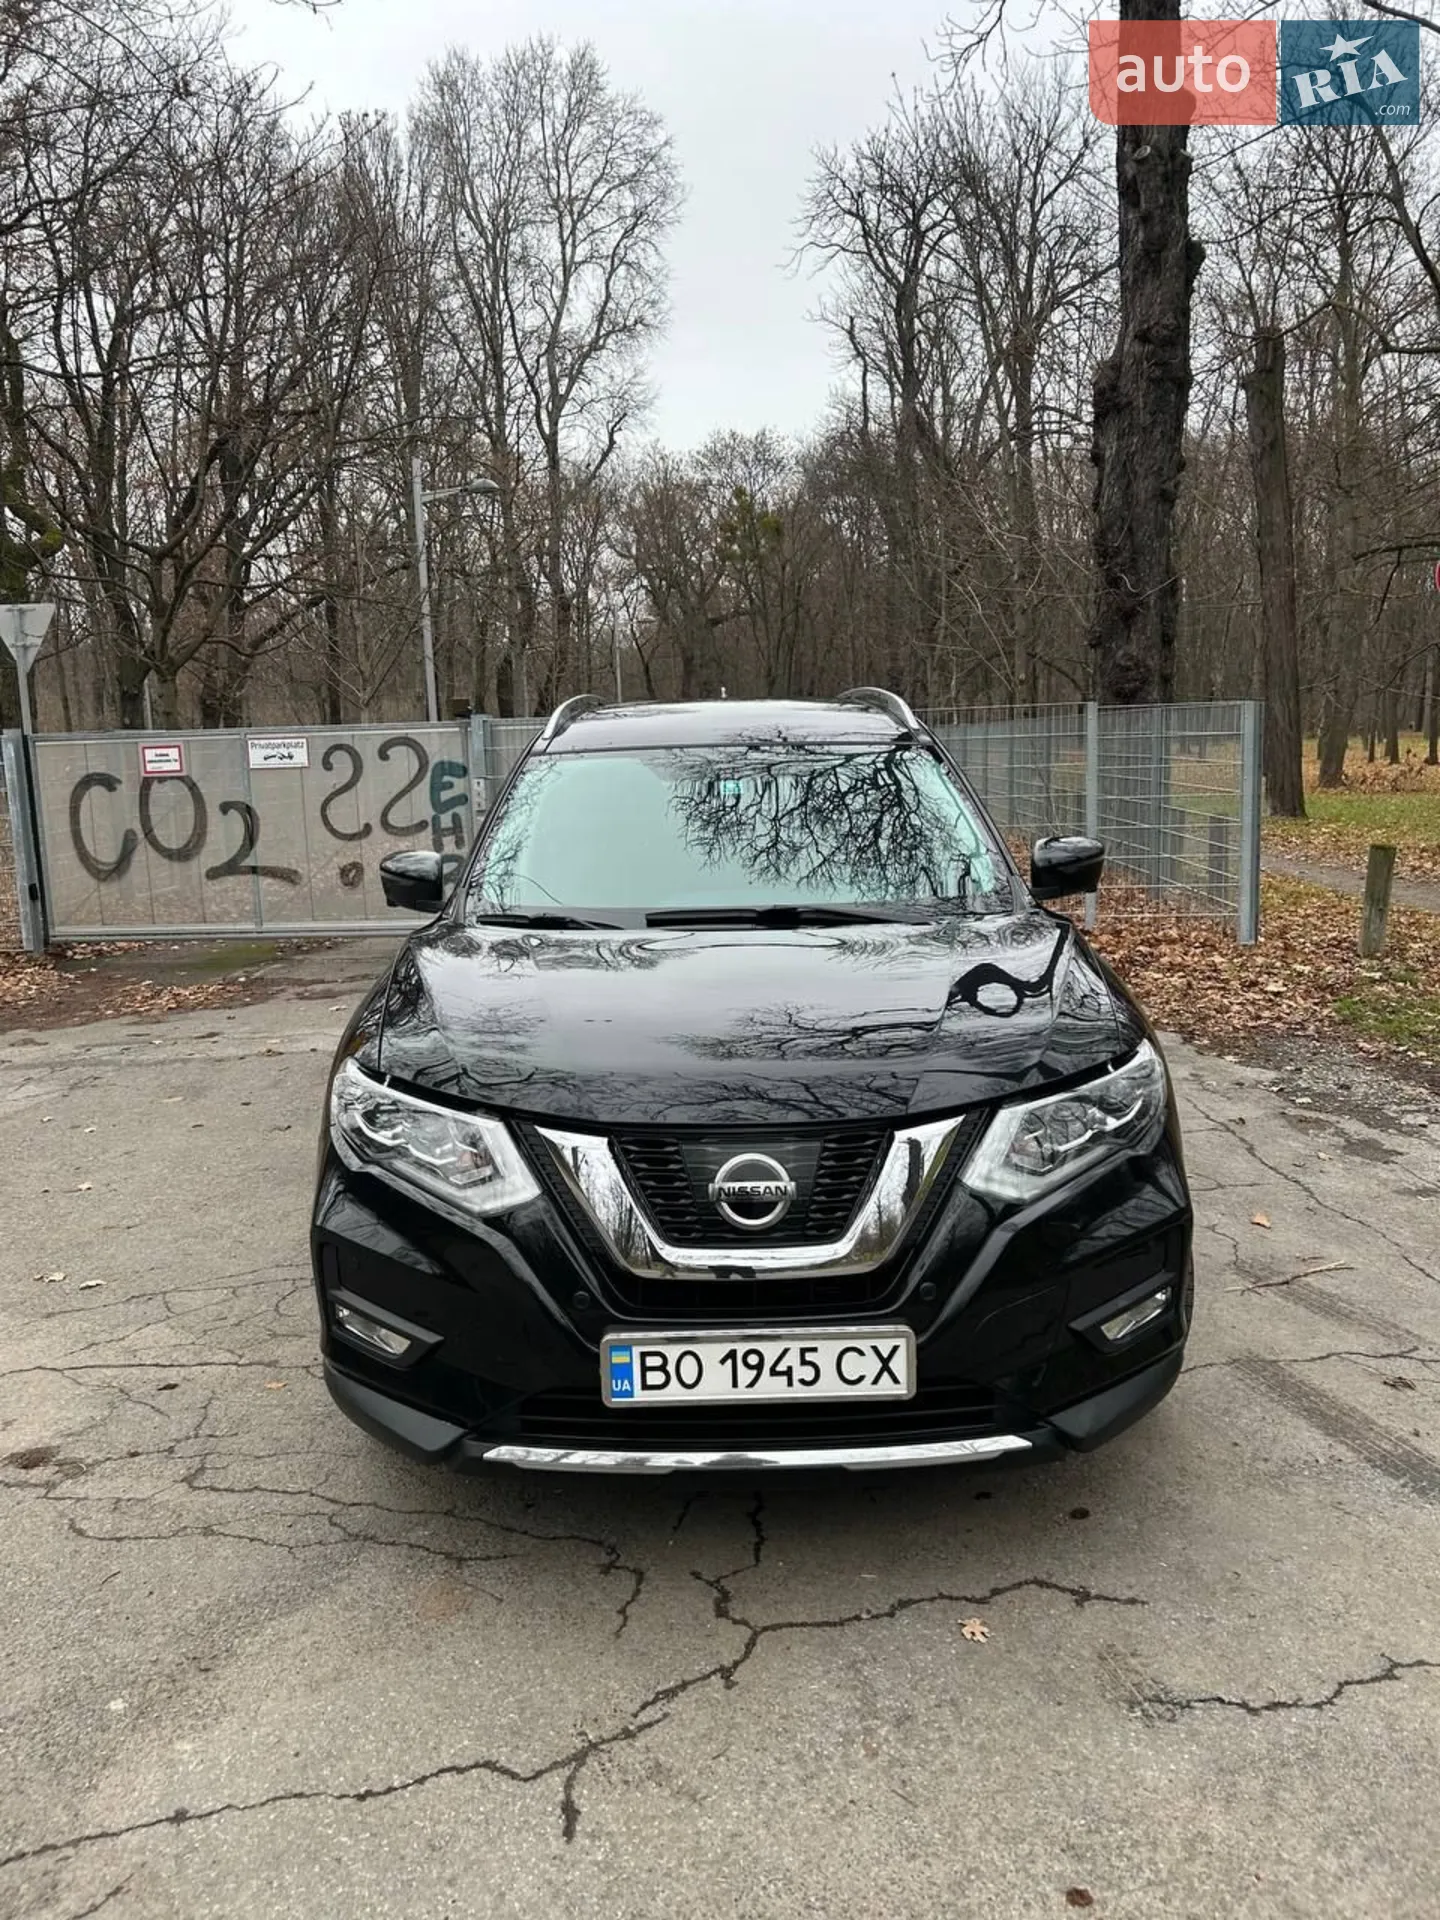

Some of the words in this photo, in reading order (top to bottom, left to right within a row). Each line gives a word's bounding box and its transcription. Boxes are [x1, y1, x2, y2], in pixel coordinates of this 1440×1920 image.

[250, 741, 304, 750] Privatparkplatz
[718, 1185, 788, 1198] NISSAN
[639, 1350, 704, 1391] BO
[718, 1347, 821, 1389] 1945
[835, 1344, 901, 1386] CX
[612, 1379, 632, 1392] UA
